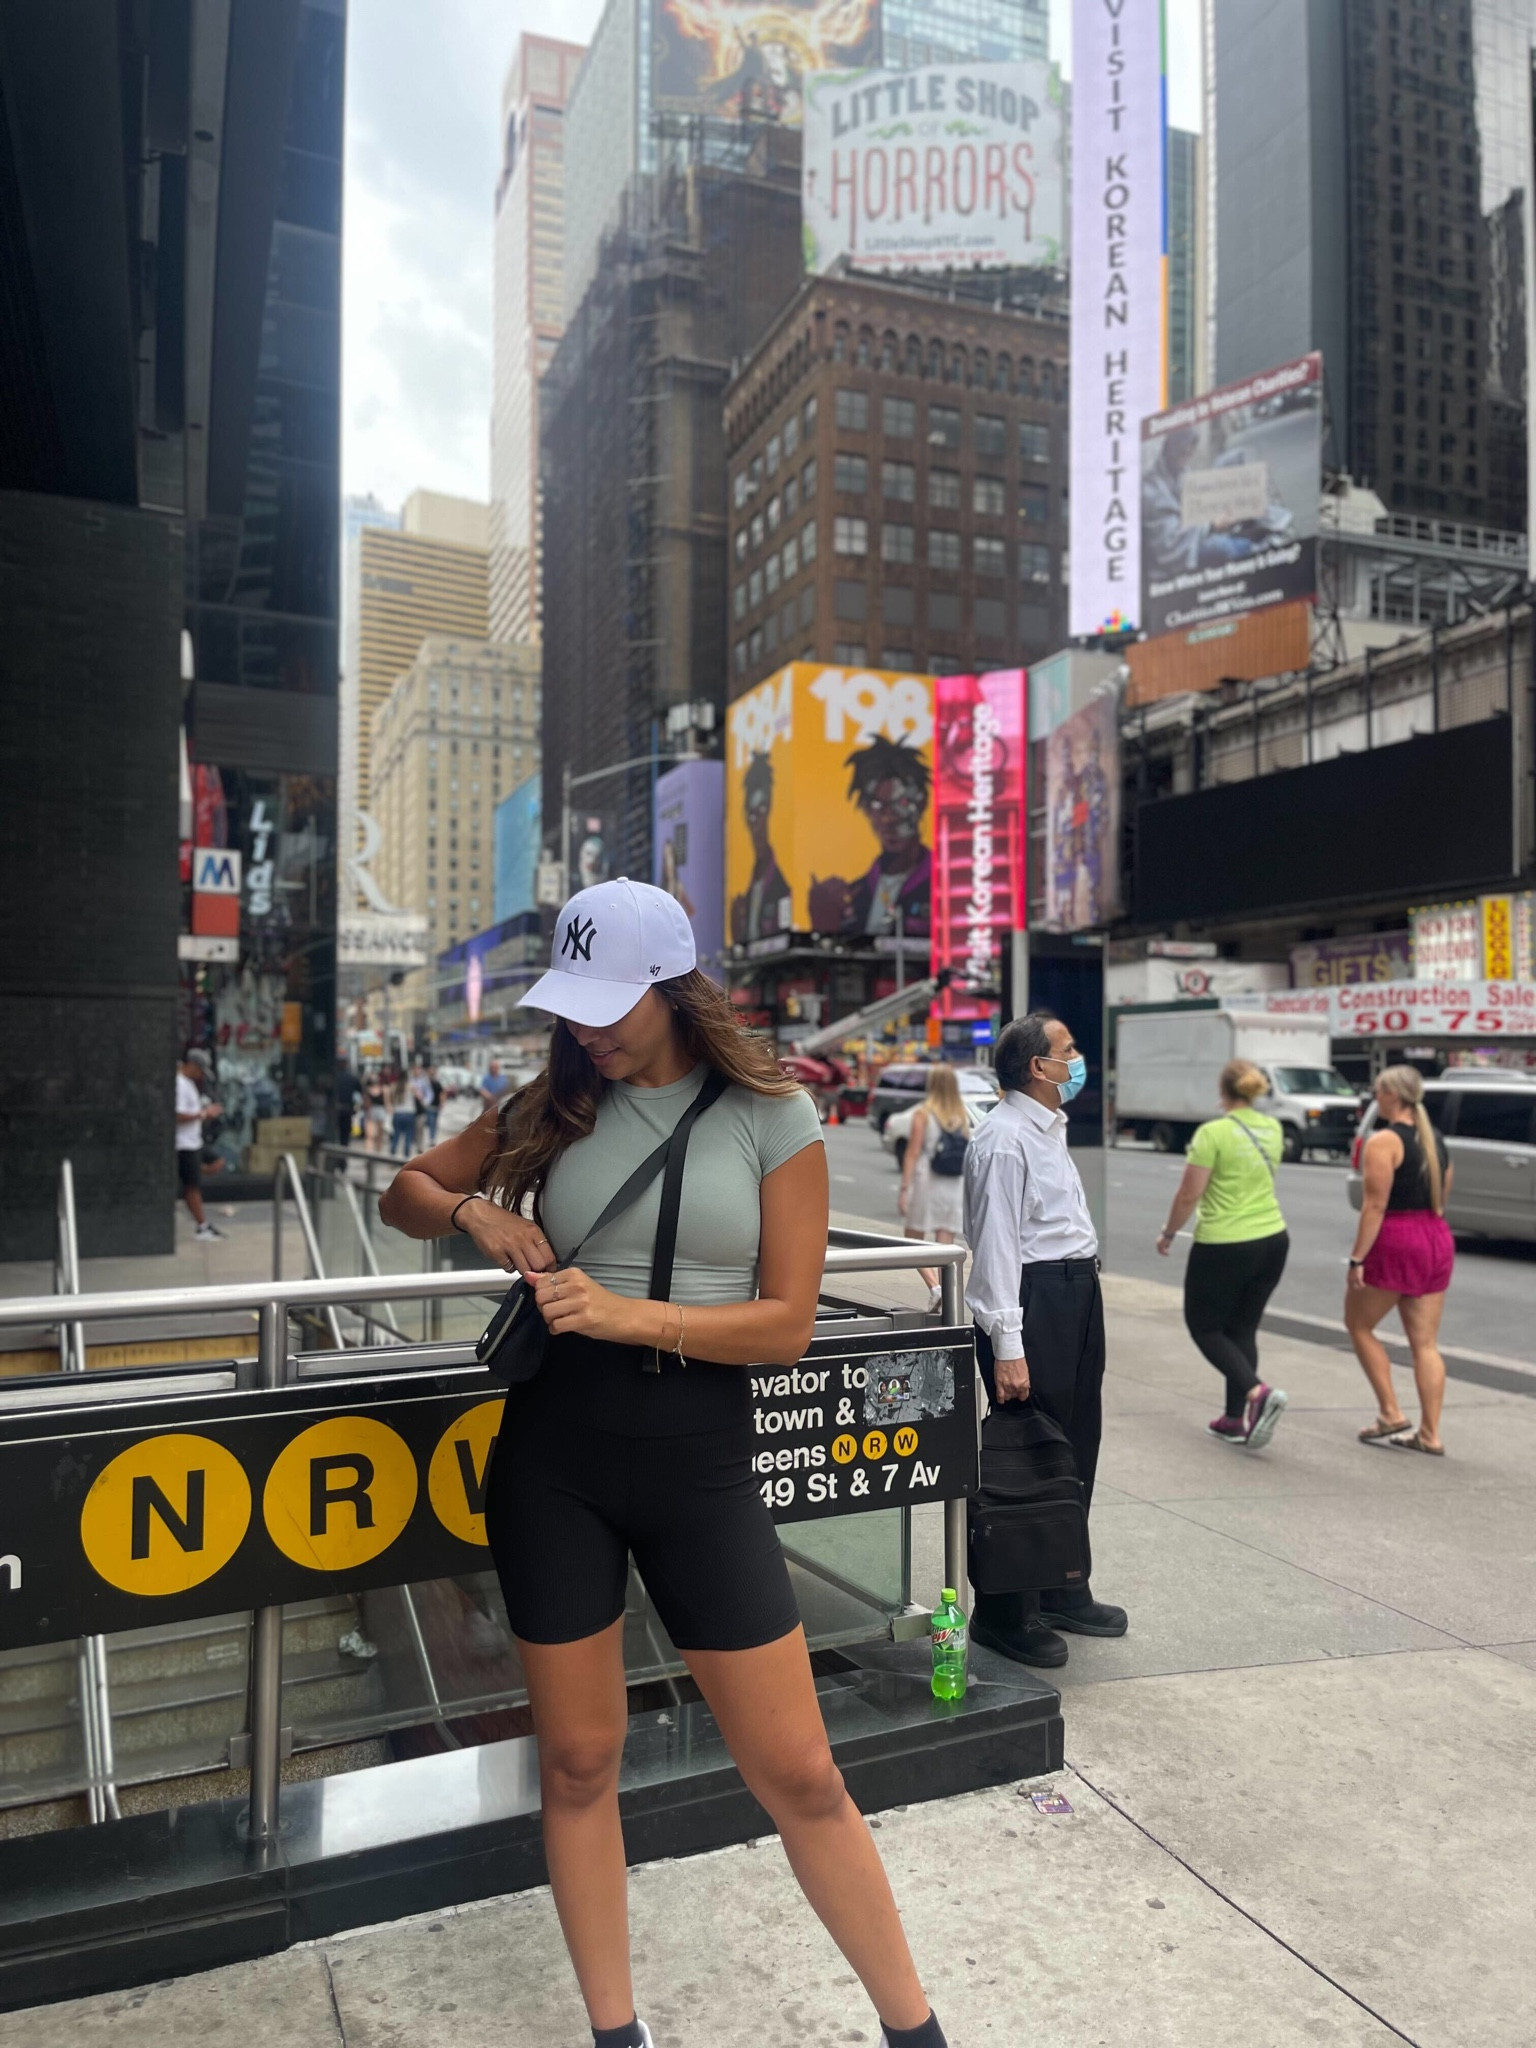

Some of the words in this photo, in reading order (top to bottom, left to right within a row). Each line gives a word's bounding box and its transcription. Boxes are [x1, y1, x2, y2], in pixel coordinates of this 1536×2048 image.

[1105, 0, 1127, 132] VISIT
[831, 73, 946, 139] LITTLE
[955, 76, 1041, 132] SHOP
[830, 142, 1037, 248] HORRORS
[1103, 153, 1130, 329] KOREAN
[1103, 348, 1129, 582] HERITAGE
[967, 702, 1001, 822] Heritage
[965, 824, 993, 924] Korean
[561, 914, 597, 961] NY
[1312, 954, 1391, 987] GIFTS
[1337, 986, 1470, 1011] Construction
[1487, 984, 1536, 1007] Sale
[842, 1363, 869, 1389] to
[753, 1407, 823, 1434] town
[835, 1396, 856, 1425] &
[752, 1445, 826, 1474] eens
[760, 1477, 795, 1508] 49
[806, 1472, 838, 1503] St
[850, 1468, 870, 1497] &
[881, 1463, 899, 1492] 7
[909, 1460, 941, 1489] Av
[131, 1469, 206, 1561] N
[309, 1453, 376, 1537] R
